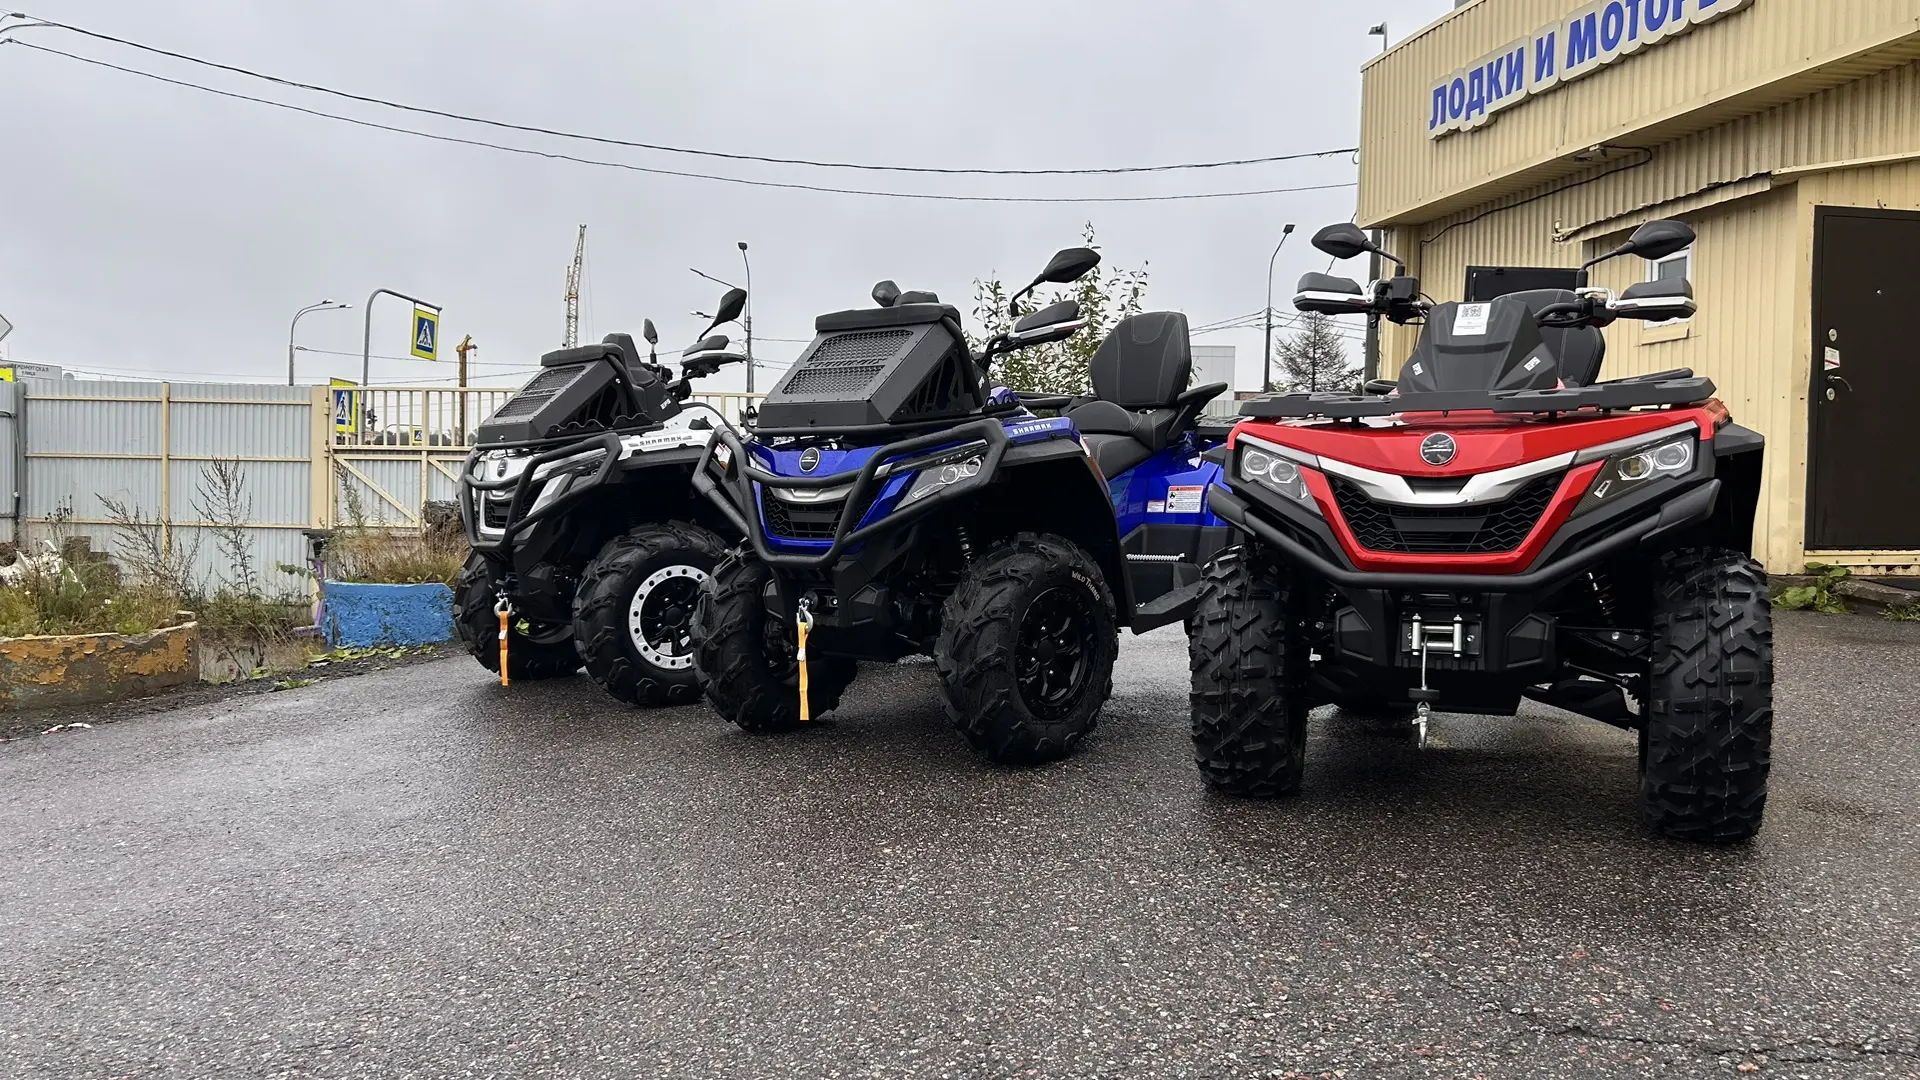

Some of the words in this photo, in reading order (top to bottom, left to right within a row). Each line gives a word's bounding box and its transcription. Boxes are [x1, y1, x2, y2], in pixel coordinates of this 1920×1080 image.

[1429, 46, 1525, 131] ЛОДКИ
[1534, 31, 1556, 84] И
[1566, 0, 1718, 70] МОТО
[1071, 570, 1086, 583] WILD
